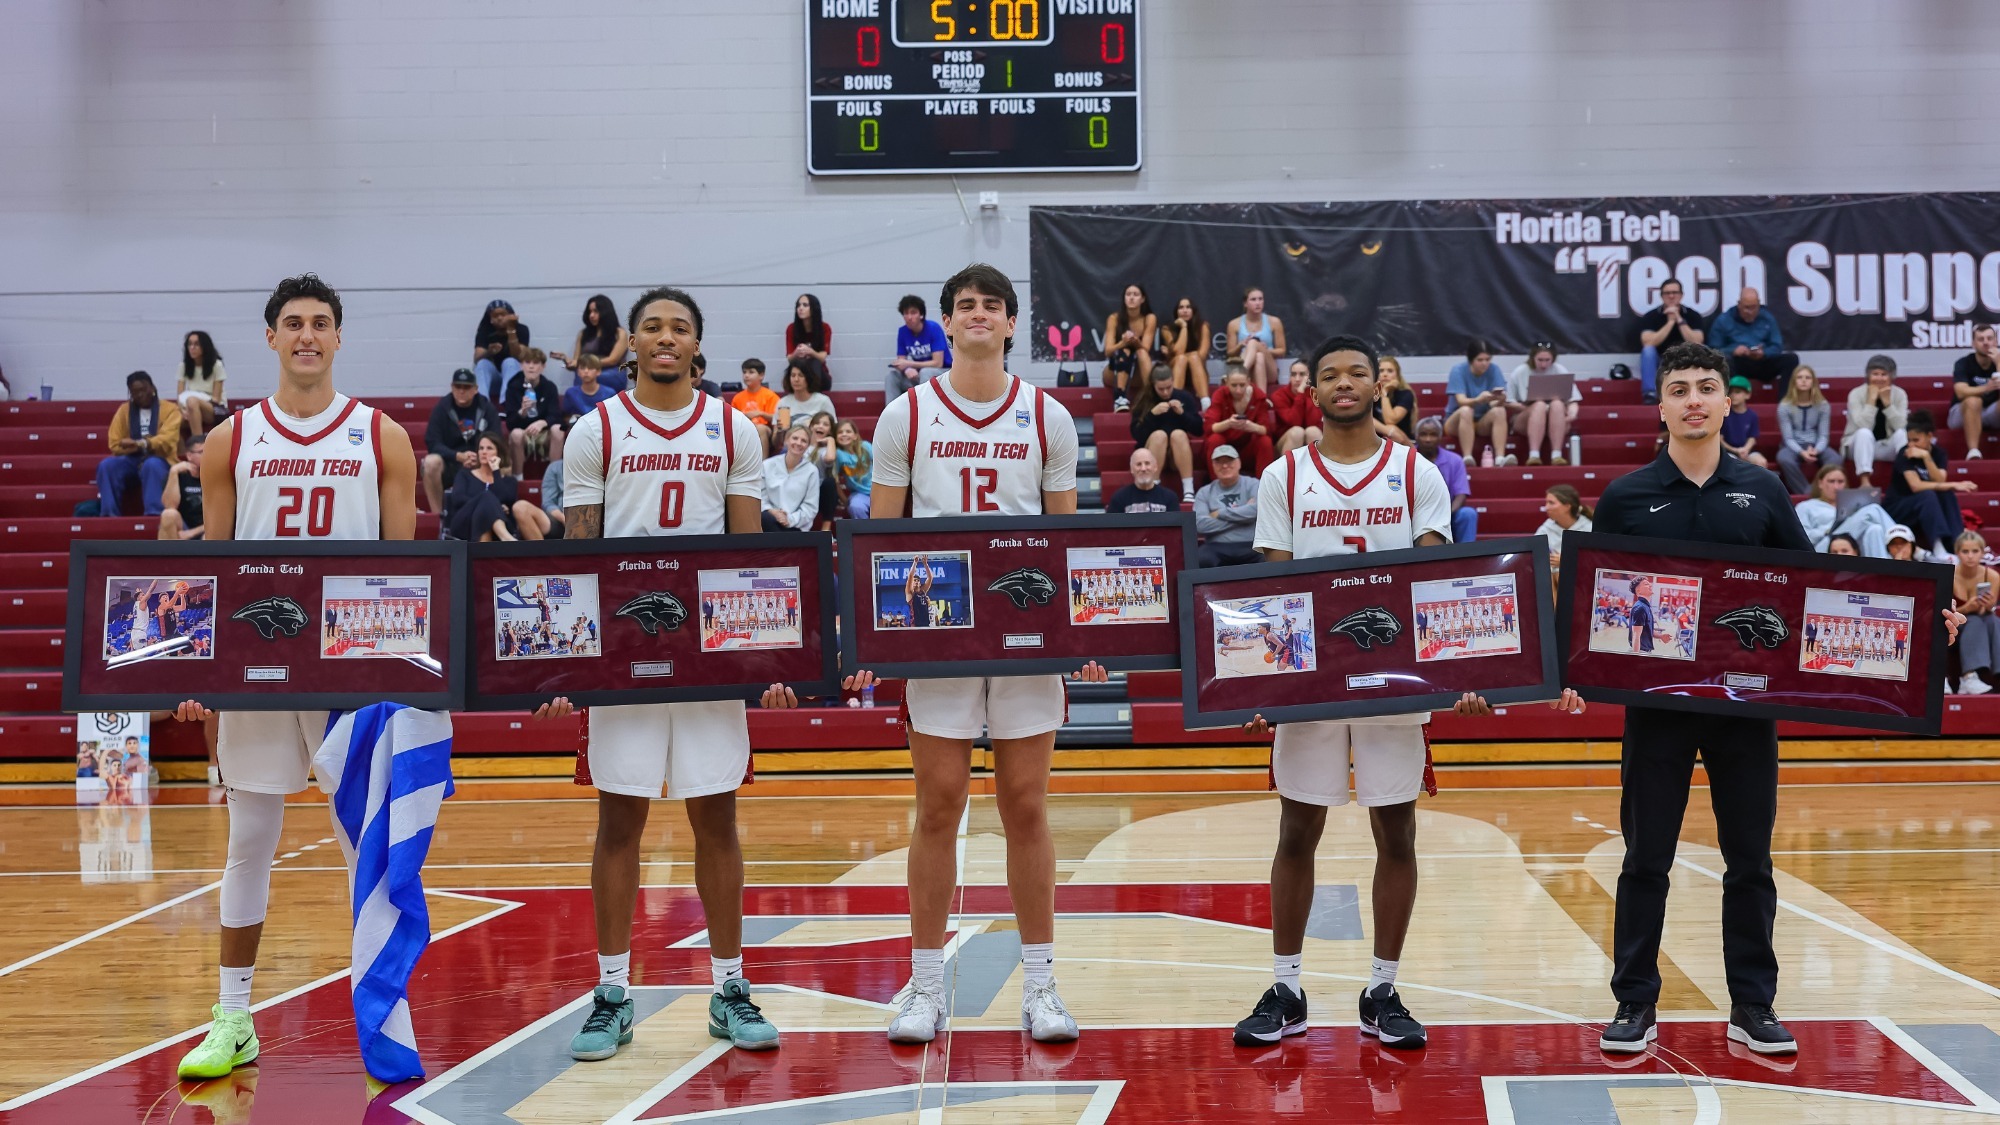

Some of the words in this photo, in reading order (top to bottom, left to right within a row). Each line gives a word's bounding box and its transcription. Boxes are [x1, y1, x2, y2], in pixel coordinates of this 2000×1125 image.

[821, 0, 880, 18] HOME
[1057, 0, 1133, 15] VISITOR
[931, 0, 1039, 41] 5:00
[857, 26, 880, 67] 0
[1101, 23, 1125, 64] 0
[944, 50, 972, 63] POSS
[932, 63, 985, 79] PERIOD
[1054, 72, 1103, 88] BONUS
[844, 75, 892, 91] BONUS
[837, 101, 882, 116] FOULS
[925, 100, 978, 115] PLAYER
[990, 99, 1036, 114] FOULS
[1066, 98, 1111, 113] FOULS
[860, 119, 879, 150] 0
[1089, 116, 1108, 148] 0
[1495, 211, 1601, 243] Florida
[1605, 210, 1681, 242] Tech
[1911, 319, 2000, 349] Stud
[929, 441, 988, 459] FLORIDA
[992, 442, 1029, 460] TECH
[250, 458, 316, 478] FLORIDA
[321, 458, 363, 478] TECH
[620, 453, 682, 473] FLORIDA
[687, 453, 722, 473] TECH
[959, 466, 999, 514] 12
[275, 485, 336, 538] 20
[658, 480, 687, 530] 0
[1301, 508, 1360, 529] FLORIDA
[1366, 505, 1404, 526] TECH
[988, 538, 1023, 549] Florida
[1026, 537, 1049, 548] Tech
[238, 564, 275, 575] Florida
[279, 564, 304, 576] Tech
[616, 560, 652, 572] Florida
[656, 559, 680, 570] Tech
[1330, 576, 1366, 589] Florida
[1369, 573, 1393, 585] Tech
[1722, 568, 1760, 581] Florida
[1764, 571, 1788, 585] Tech
